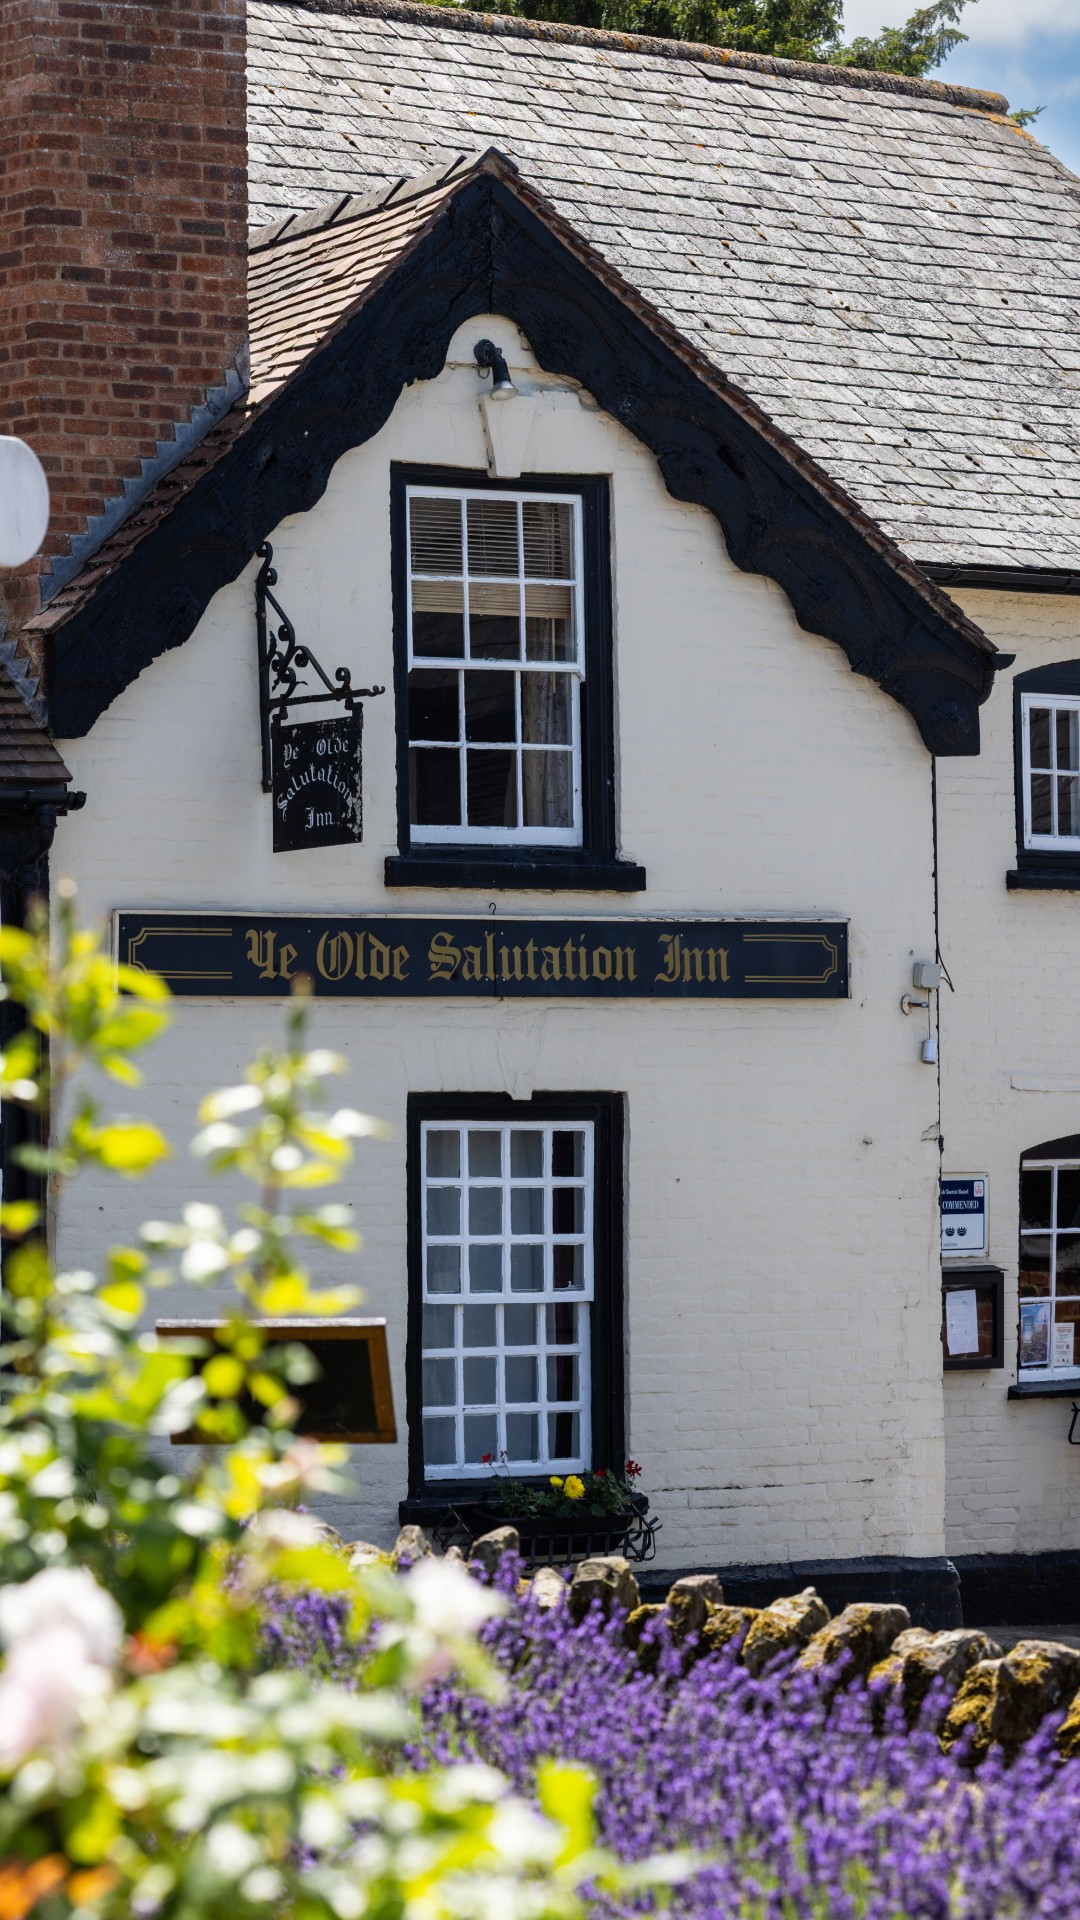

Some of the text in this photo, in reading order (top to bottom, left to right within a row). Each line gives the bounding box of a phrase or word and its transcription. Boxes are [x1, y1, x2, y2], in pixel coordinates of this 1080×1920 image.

[283, 737, 349, 768] Ye Olde
[277, 762, 353, 821] Salutation
[304, 806, 334, 831] Inn
[245, 928, 731, 983] Ye Olde Salutation Inn
